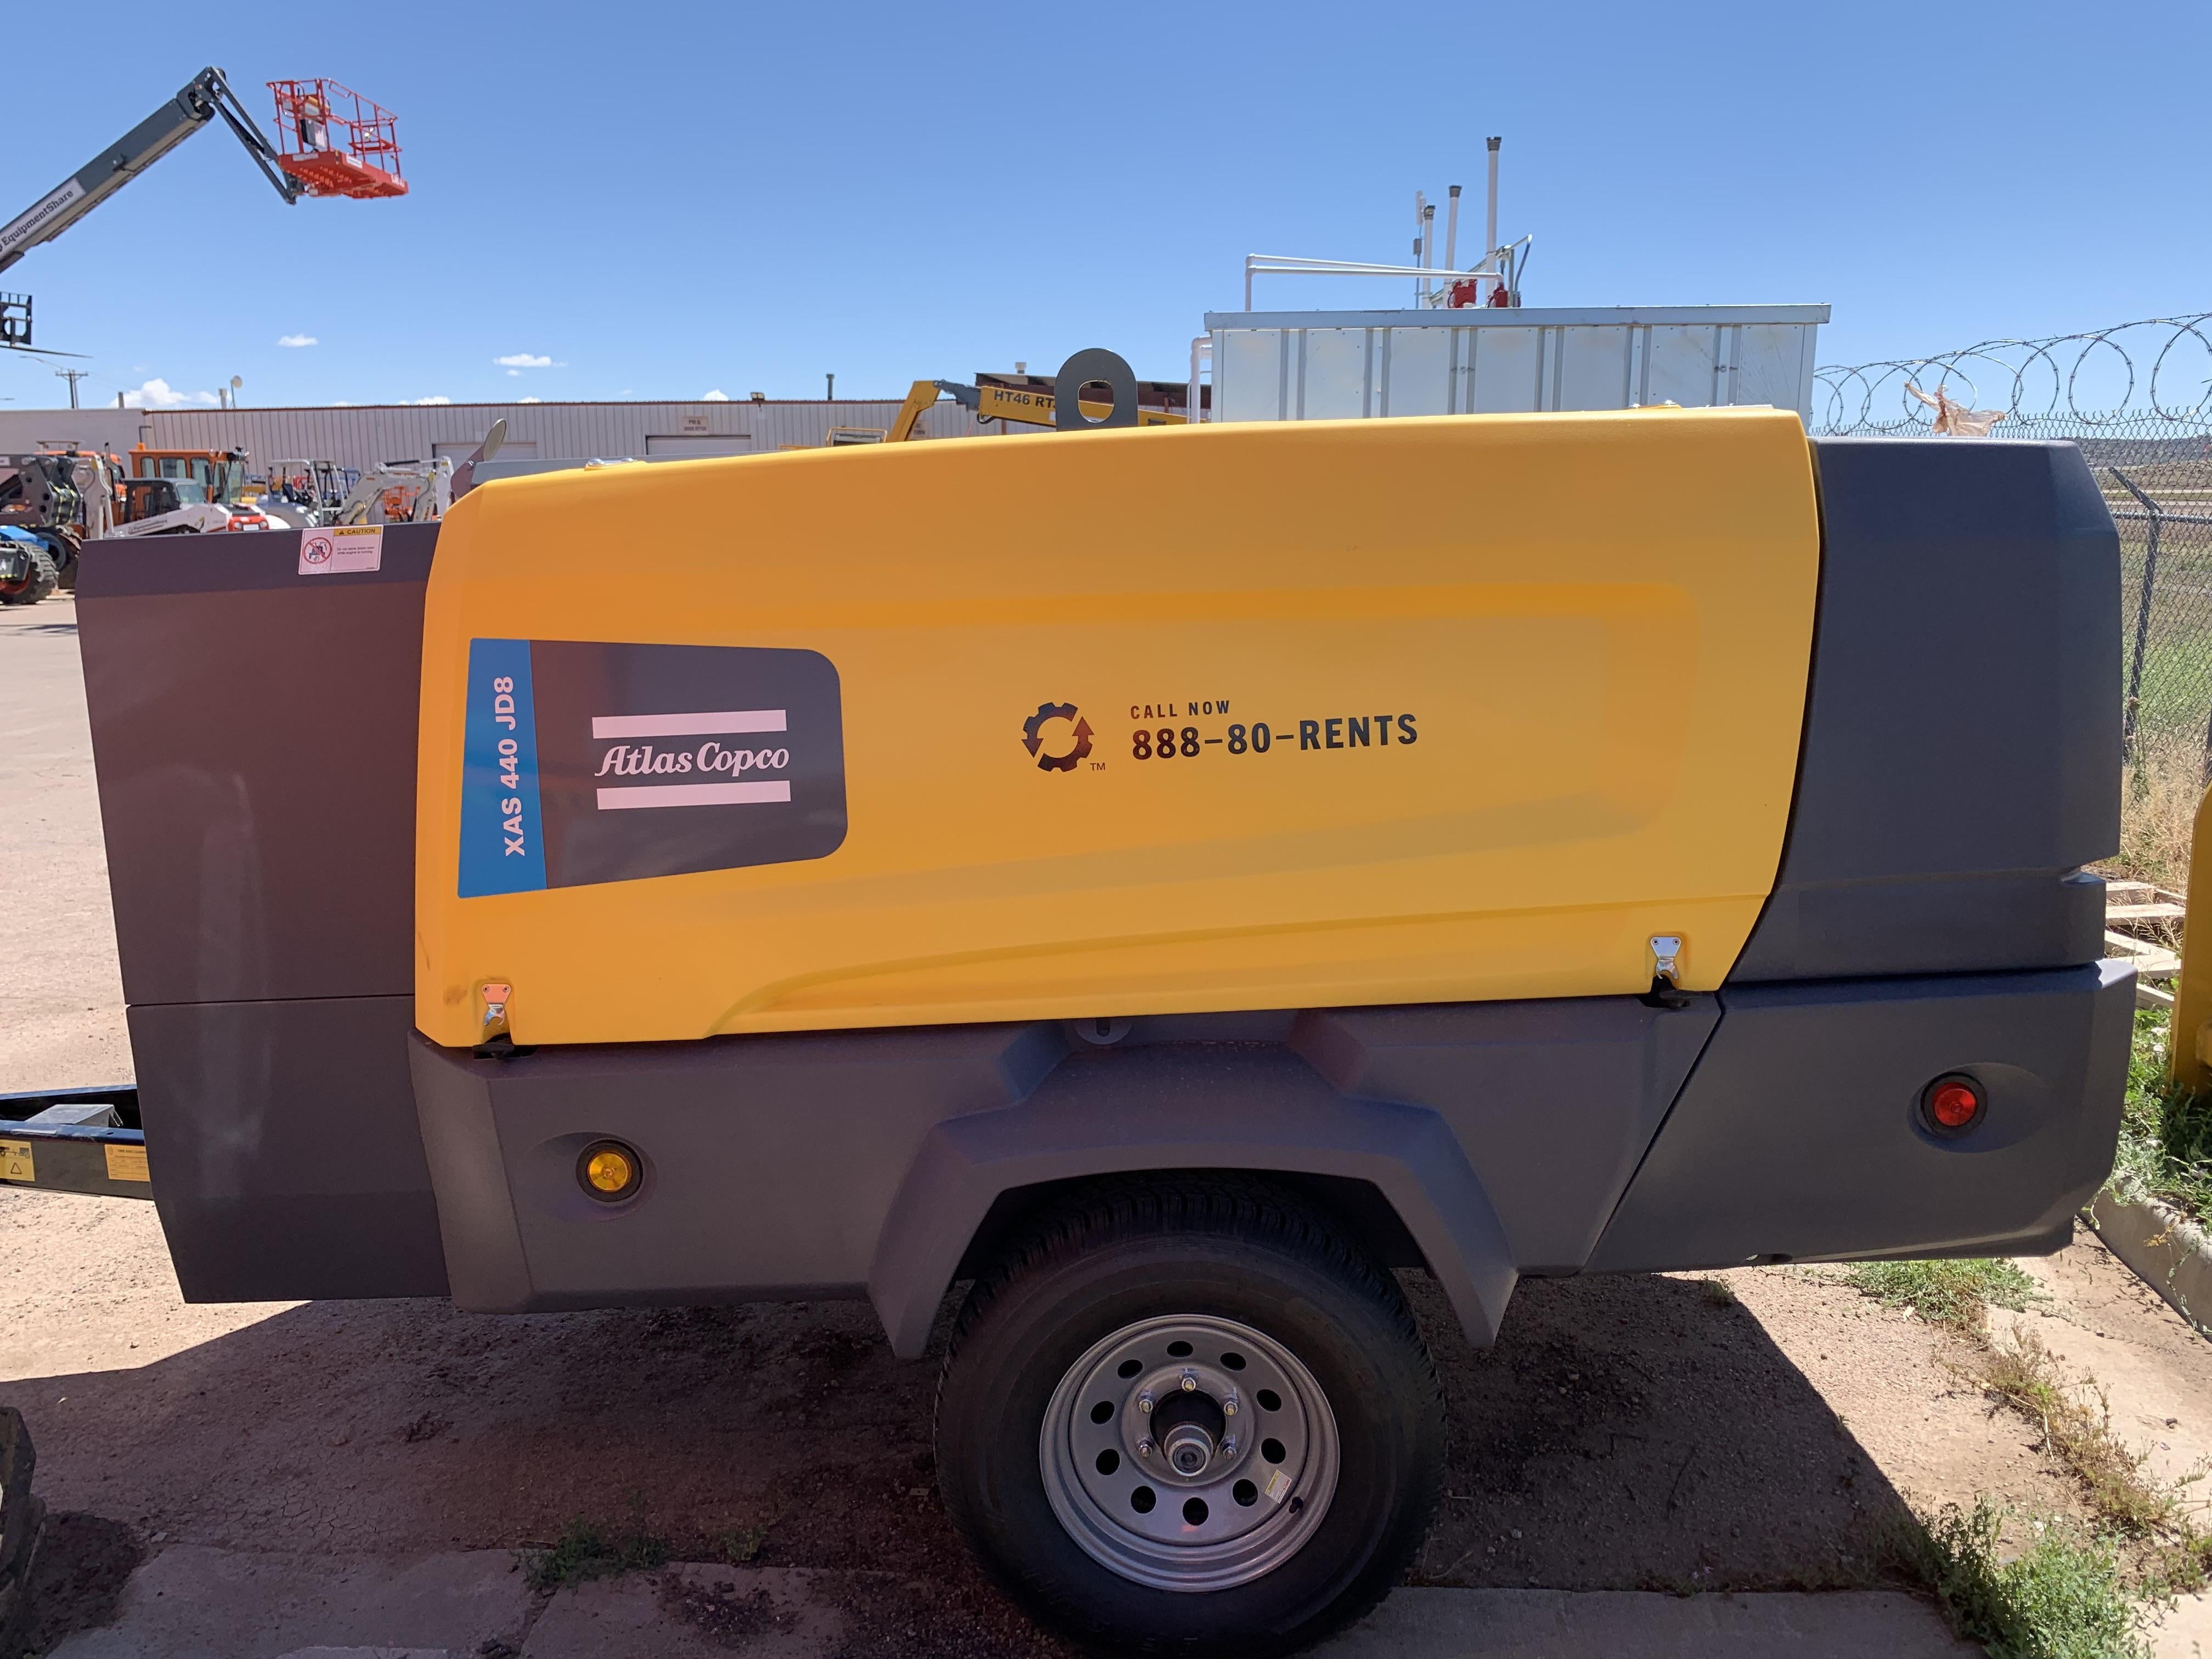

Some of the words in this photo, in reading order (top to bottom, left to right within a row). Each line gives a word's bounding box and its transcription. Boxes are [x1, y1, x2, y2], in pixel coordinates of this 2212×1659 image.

[2, 190, 73, 245] EquipmentShare
[994, 390, 1030, 404] HT46
[1035, 396, 1056, 409] RT
[494, 676, 516, 731] JD8
[1130, 703, 1177, 719] CALL
[1188, 700, 1229, 716] NOW
[594, 746, 693, 777] Atlas
[697, 742, 789, 777] Copco
[1132, 714, 1418, 760] 888-80-RENTS
[498, 738, 519, 789] 440
[1090, 762, 1105, 771] TM
[501, 797, 525, 857] XAS
